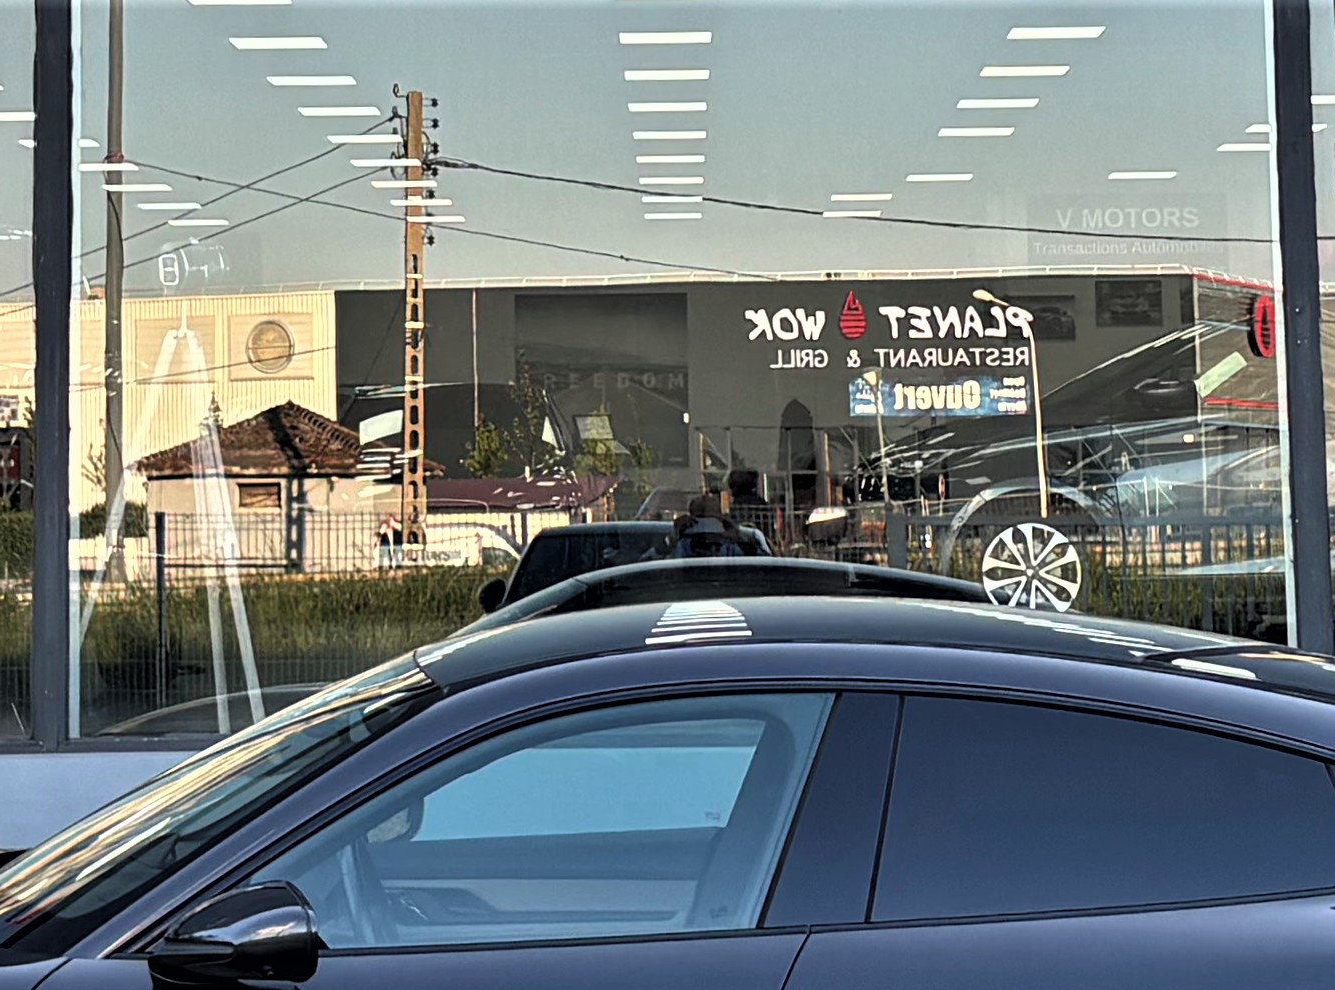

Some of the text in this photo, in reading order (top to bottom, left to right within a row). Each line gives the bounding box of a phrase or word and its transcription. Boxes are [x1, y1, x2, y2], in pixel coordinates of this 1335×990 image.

[1056, 207, 1200, 229] V MOTORS
[1034, 240, 1224, 256] Transactions Automob
[523, 371, 685, 389] REEDOM
